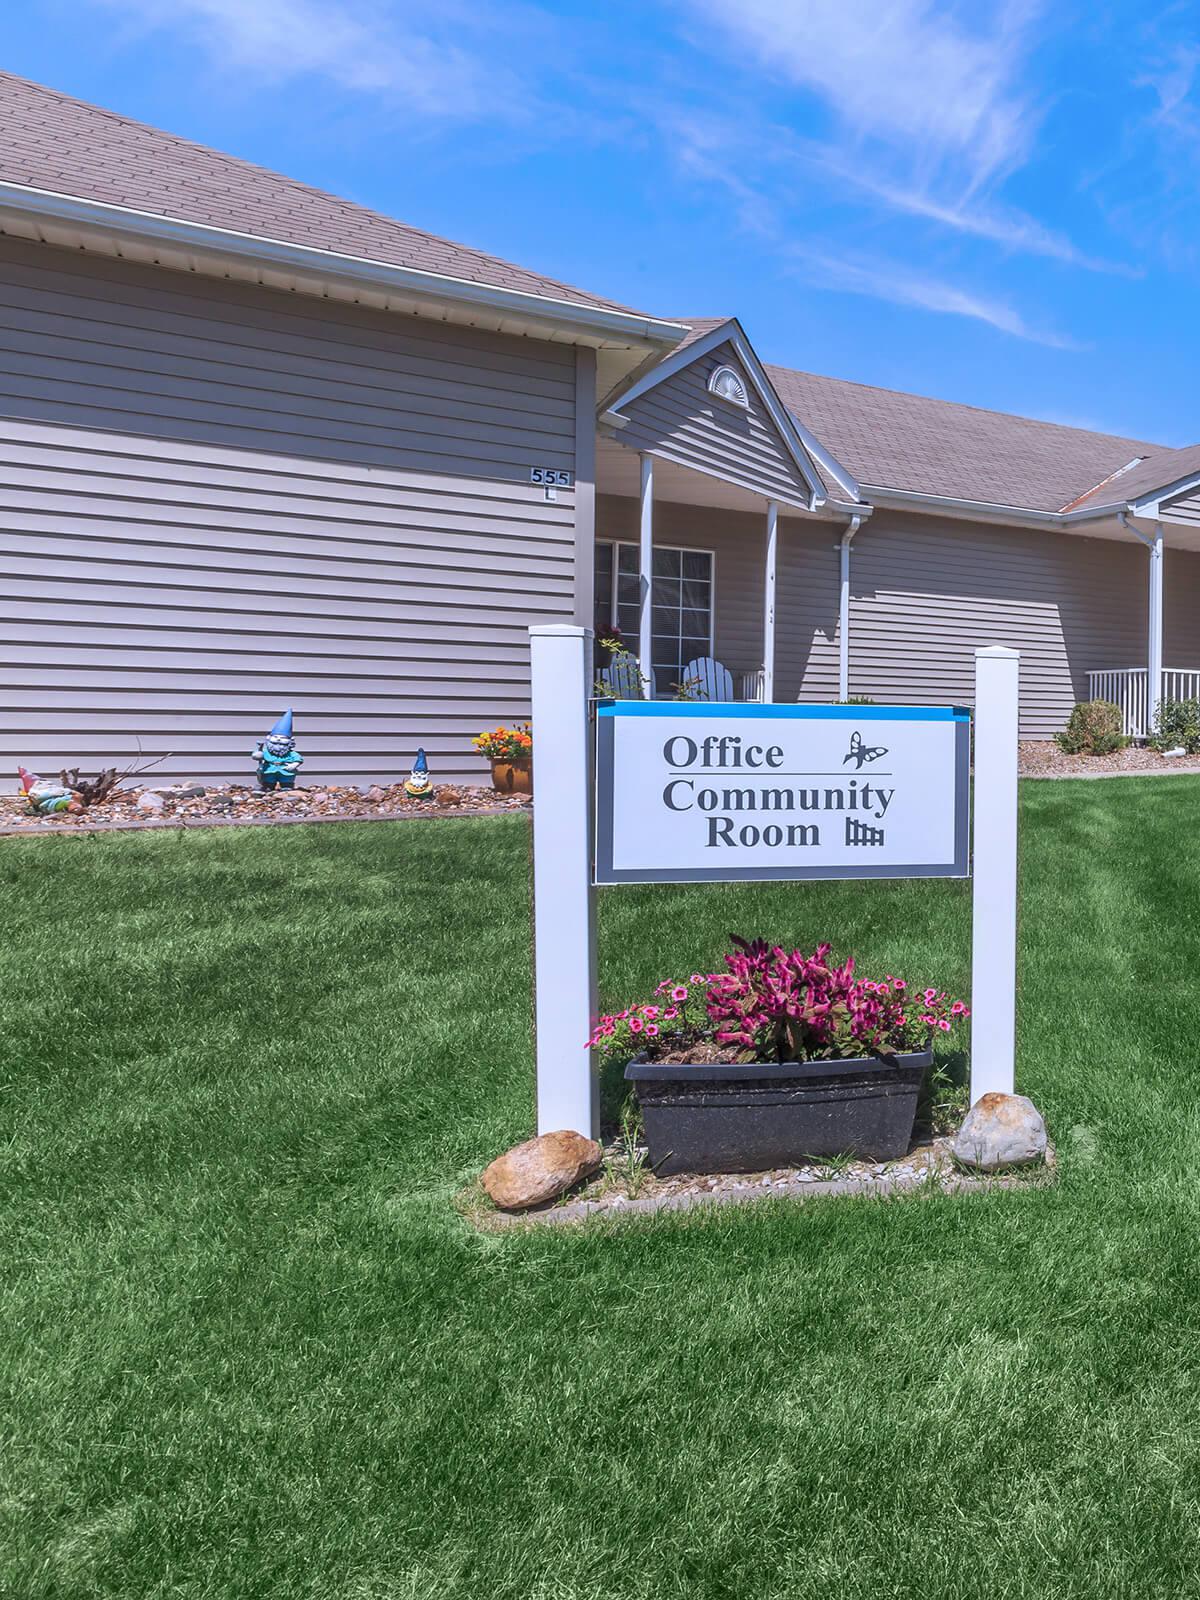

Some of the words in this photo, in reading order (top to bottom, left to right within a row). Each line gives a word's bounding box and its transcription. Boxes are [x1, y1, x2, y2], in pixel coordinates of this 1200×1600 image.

[532, 469, 569, 484] 555
[545, 487, 556, 501] L
[663, 735, 784, 768] Office
[662, 779, 896, 819] Community
[705, 816, 821, 848] Room
